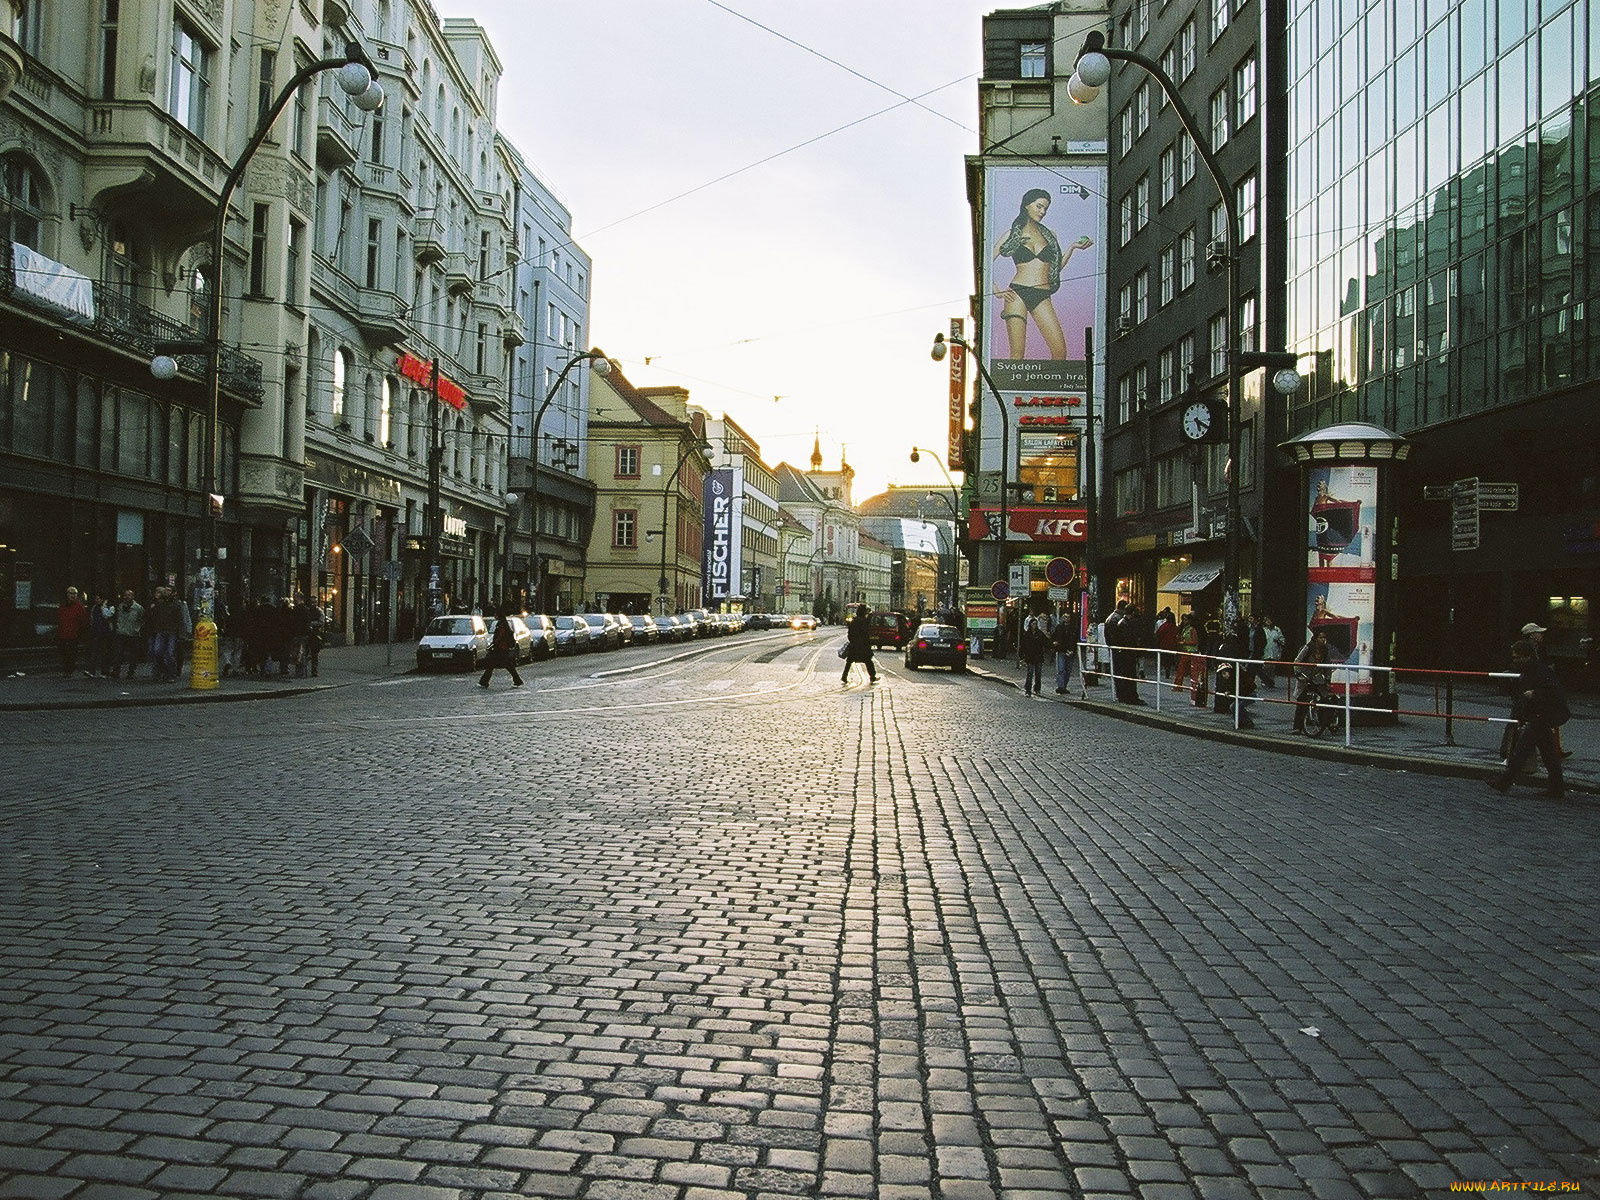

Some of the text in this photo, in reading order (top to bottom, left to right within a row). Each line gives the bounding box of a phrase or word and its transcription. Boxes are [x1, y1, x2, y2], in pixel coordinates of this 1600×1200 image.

[1060, 184, 1081, 194] DIM
[951, 352, 962, 382] KFC
[1011, 373, 1022, 381] je
[1025, 372, 1062, 381] jenom
[951, 392, 961, 421] KFC
[1014, 396, 1081, 407] LASER
[951, 430, 960, 462] KFC
[983, 479, 999, 493] 25
[1034, 519, 1085, 537] KFC
[712, 496, 729, 599] FISCHER
